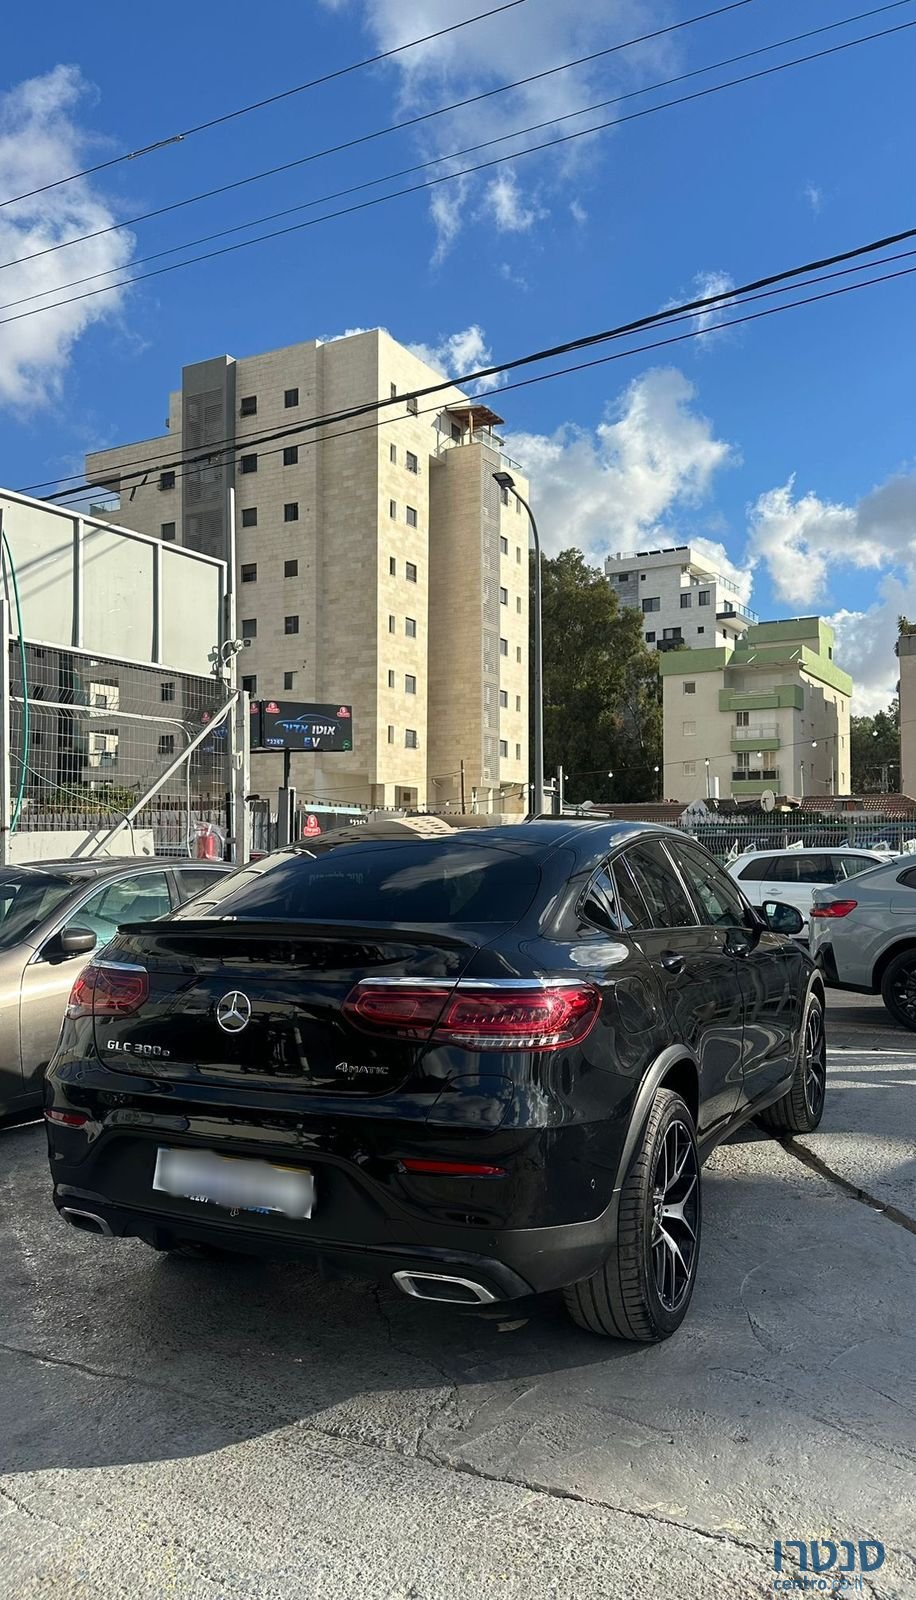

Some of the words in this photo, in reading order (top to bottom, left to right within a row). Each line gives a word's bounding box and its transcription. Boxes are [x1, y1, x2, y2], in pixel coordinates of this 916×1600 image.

[312, 725, 336, 735] אוטו
[303, 737, 320, 748] EV
[107, 1040, 132, 1052] GLC
[335, 1061, 389, 1075] 4MATIC
